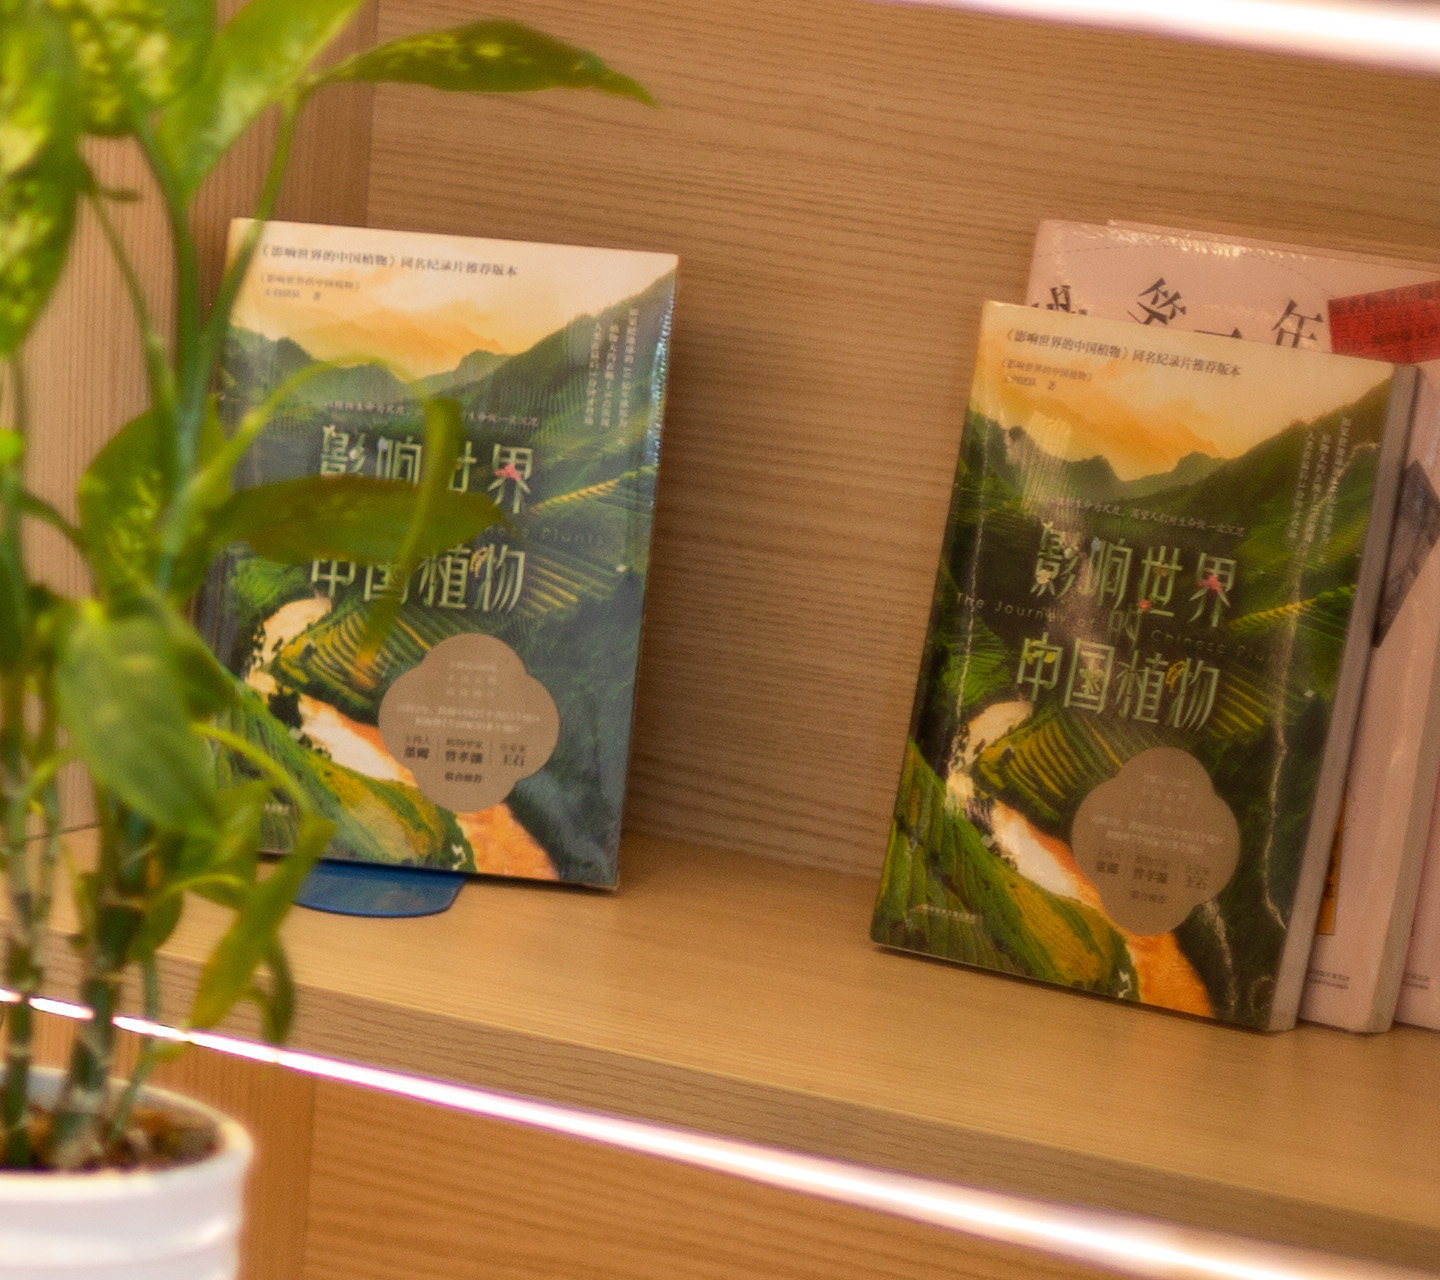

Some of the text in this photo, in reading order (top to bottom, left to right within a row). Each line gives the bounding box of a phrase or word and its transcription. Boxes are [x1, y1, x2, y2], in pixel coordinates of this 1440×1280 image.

[261, 243, 519, 279] 《影响世界的中国植物》同名纪录片推荐版本
[1006, 329, 1243, 378] 《影响世界的中国植物》同名纪录片推荐版本
[1030, 520, 1238, 629] 影响世界
[1015, 631, 1221, 732] 中国植物
